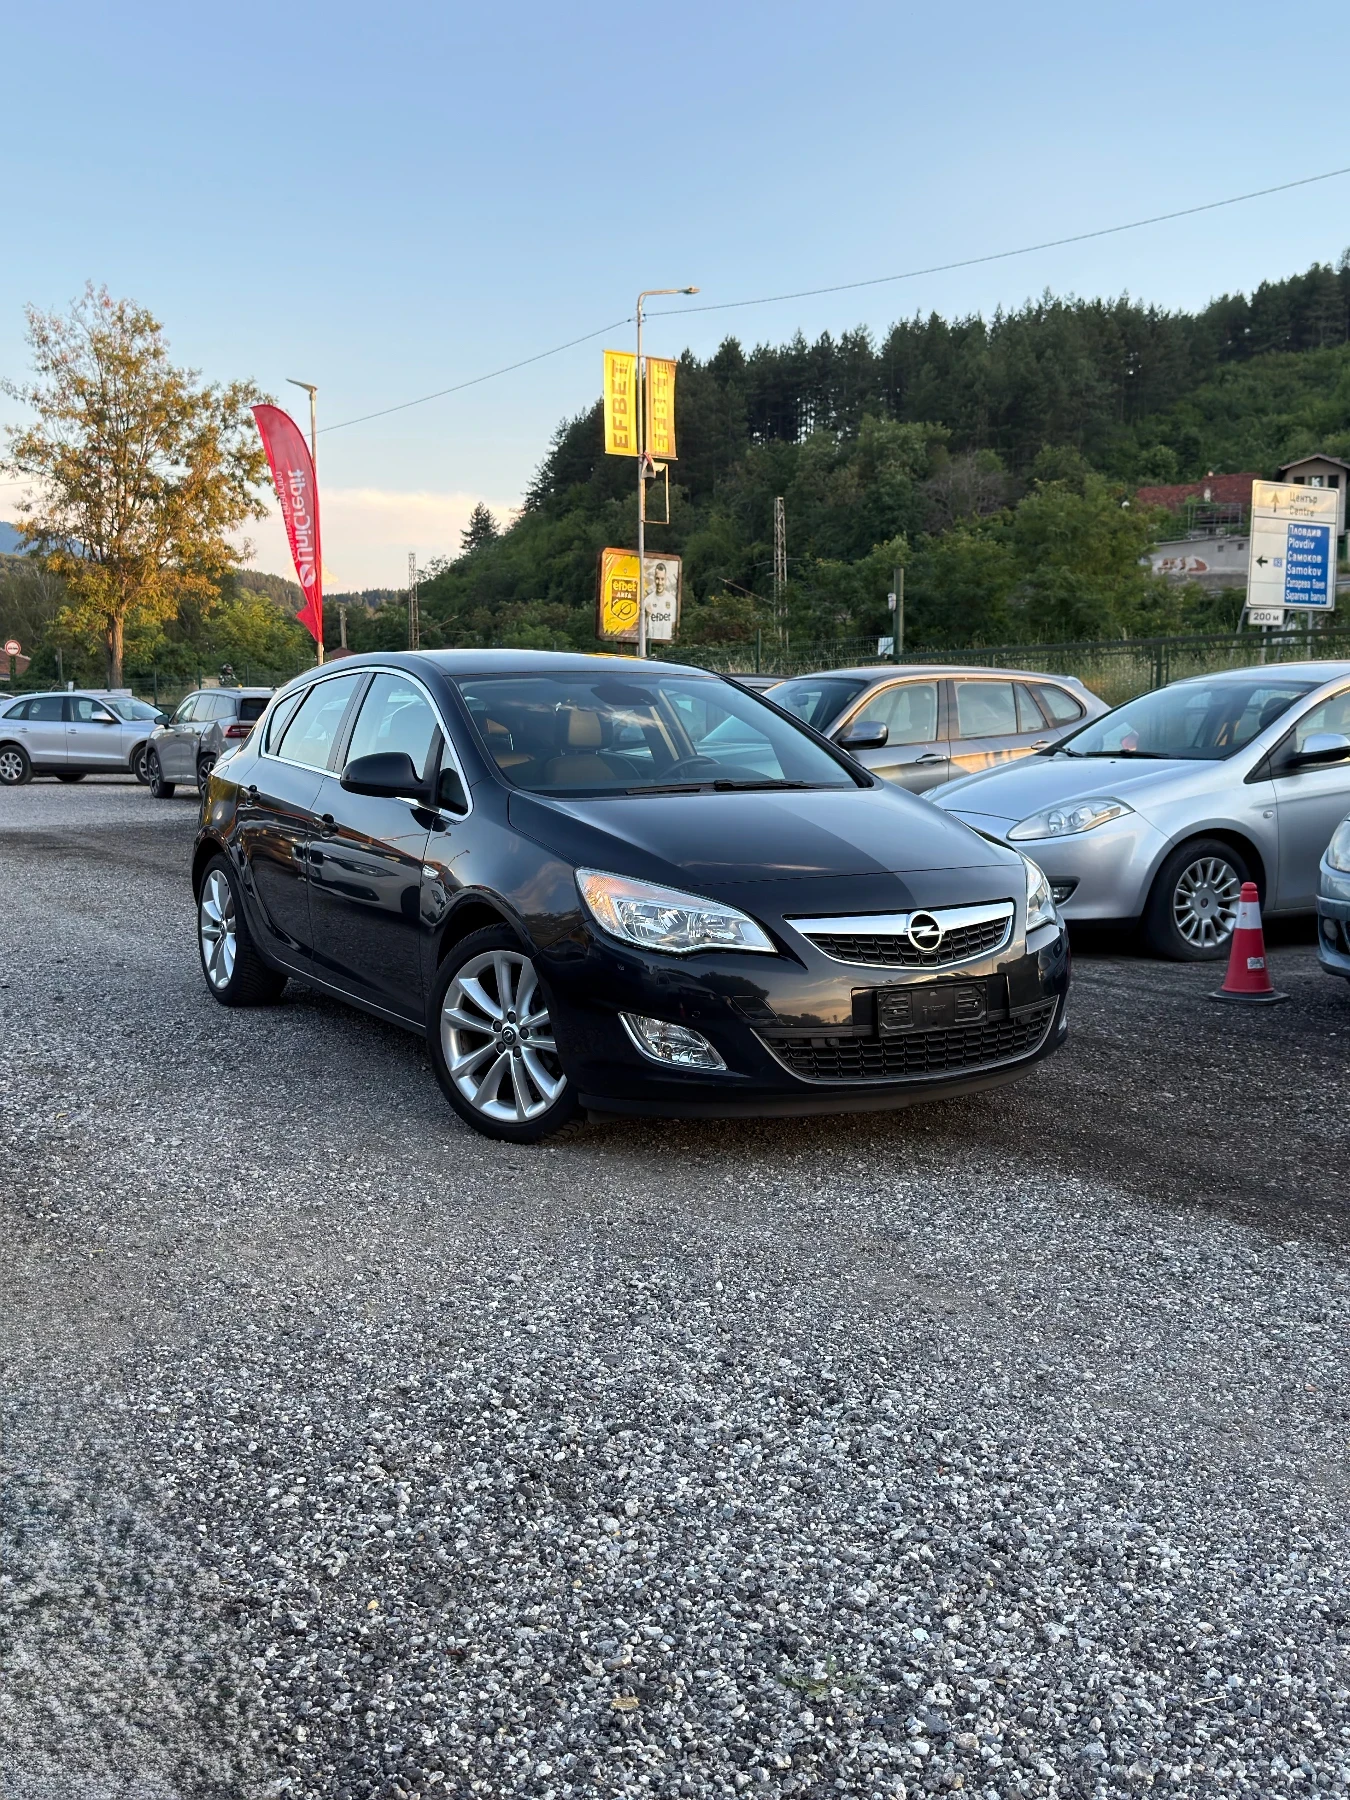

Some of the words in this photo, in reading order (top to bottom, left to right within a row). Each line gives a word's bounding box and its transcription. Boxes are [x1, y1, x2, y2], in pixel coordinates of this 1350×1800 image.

[611, 358, 629, 449] EFBET
[1289, 491, 1318, 504] Център
[1289, 505, 1315, 517] Centre
[1289, 525, 1322, 538] Пловдив
[1288, 537, 1315, 550] Plovdiv
[1288, 551, 1322, 563] Самоков
[1287, 564, 1322, 576] Samokov
[612, 580, 637, 592] efbet
[651, 613, 671, 622] efbet
[1253, 612, 1271, 621] 200
